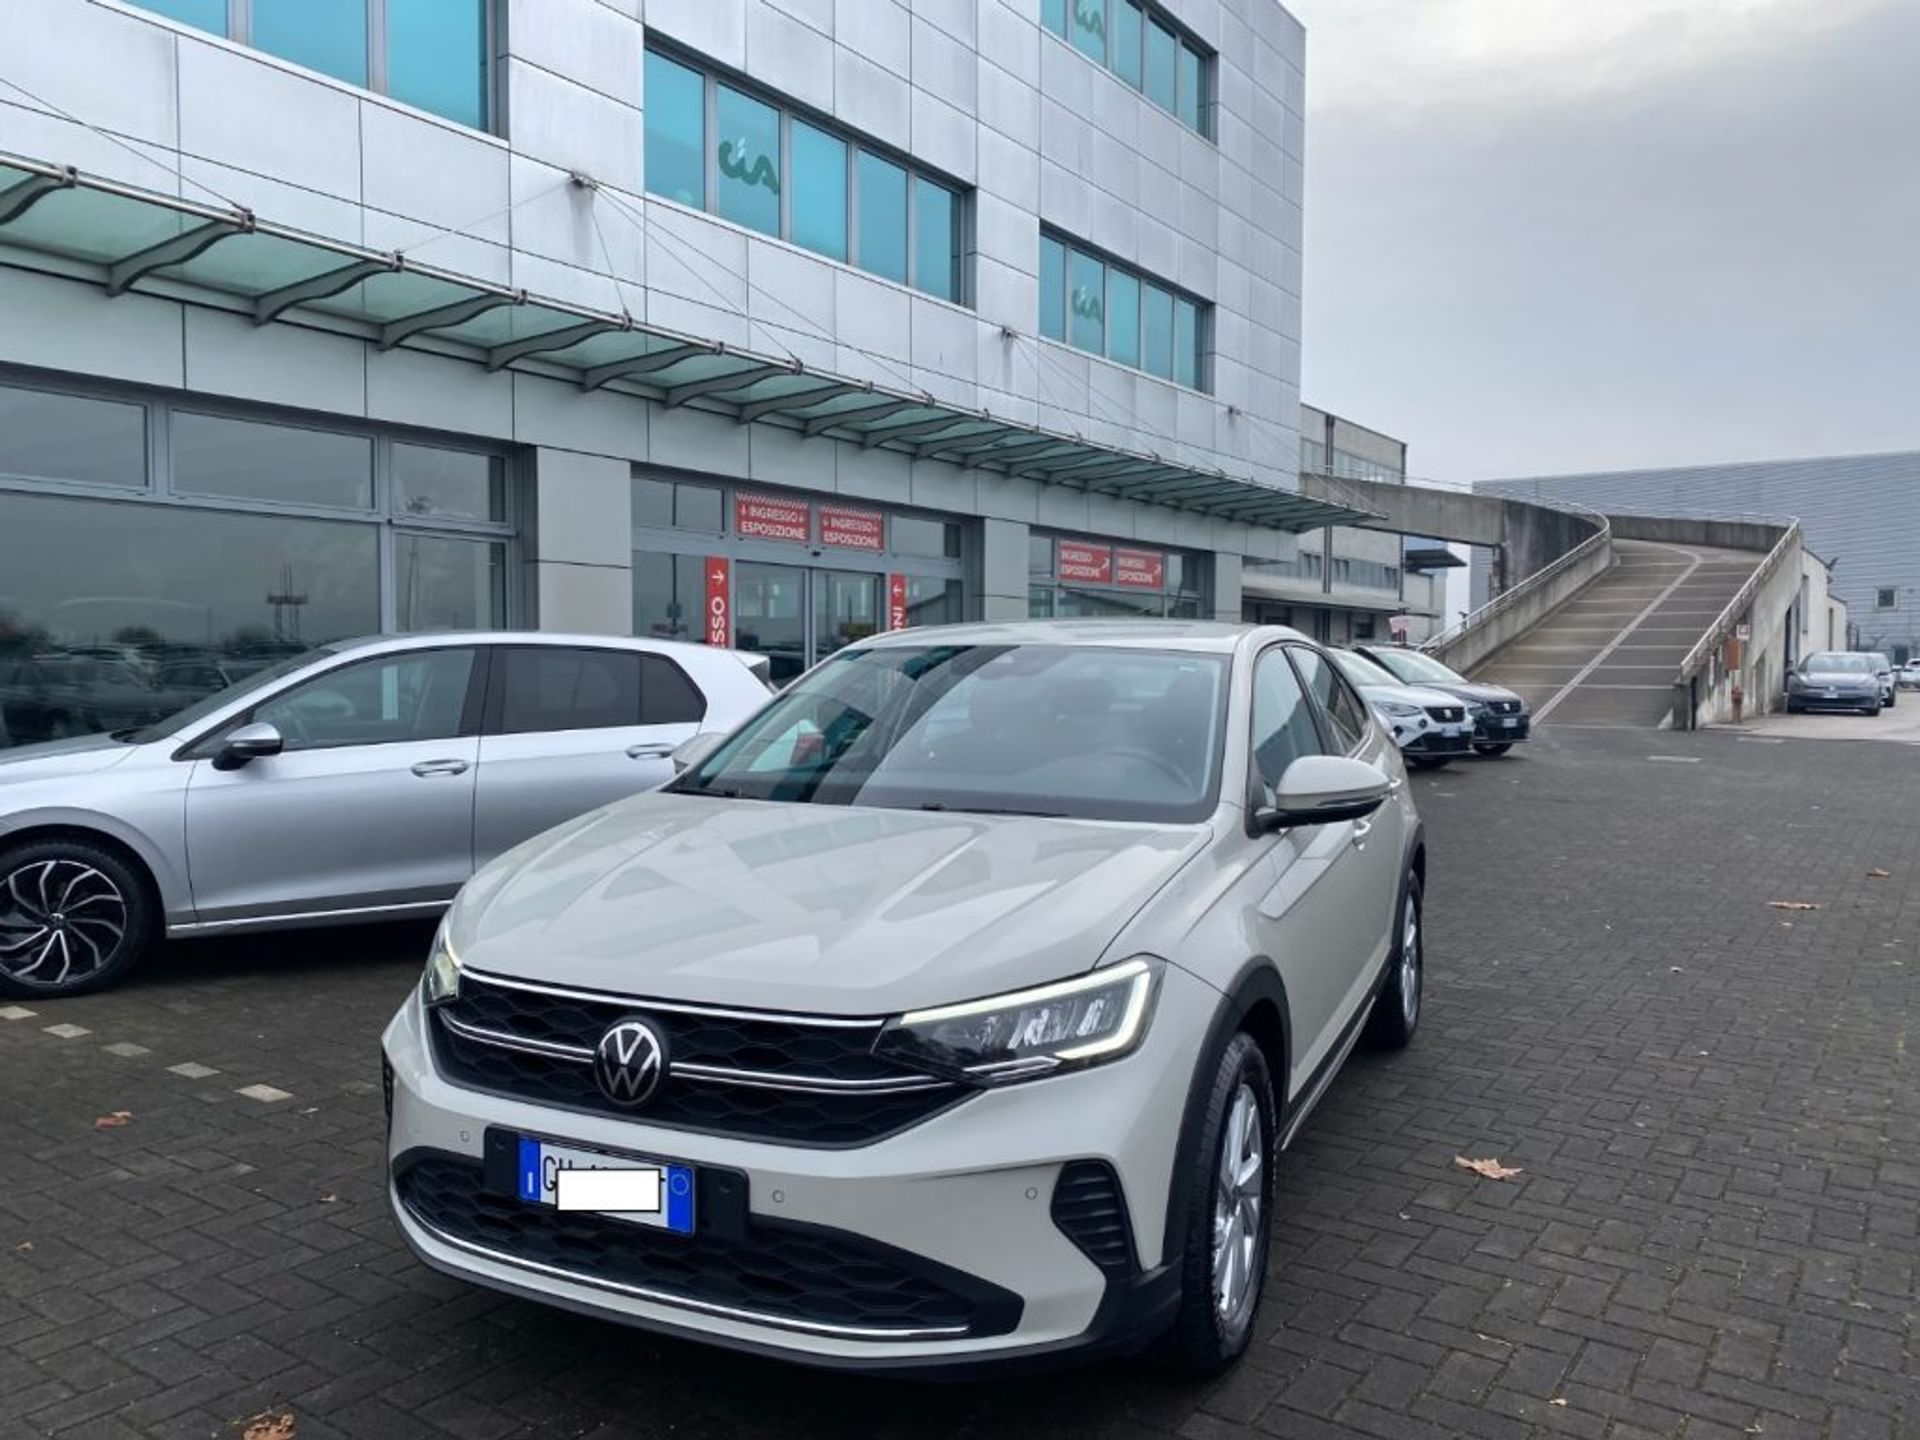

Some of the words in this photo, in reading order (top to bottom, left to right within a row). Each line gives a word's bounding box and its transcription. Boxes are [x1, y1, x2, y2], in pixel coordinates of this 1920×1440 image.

[750, 505, 798, 523] INGRESSO
[741, 520, 806, 540] ESPOSIZIONE
[823, 531, 879, 548] ESPOSIZIONE
